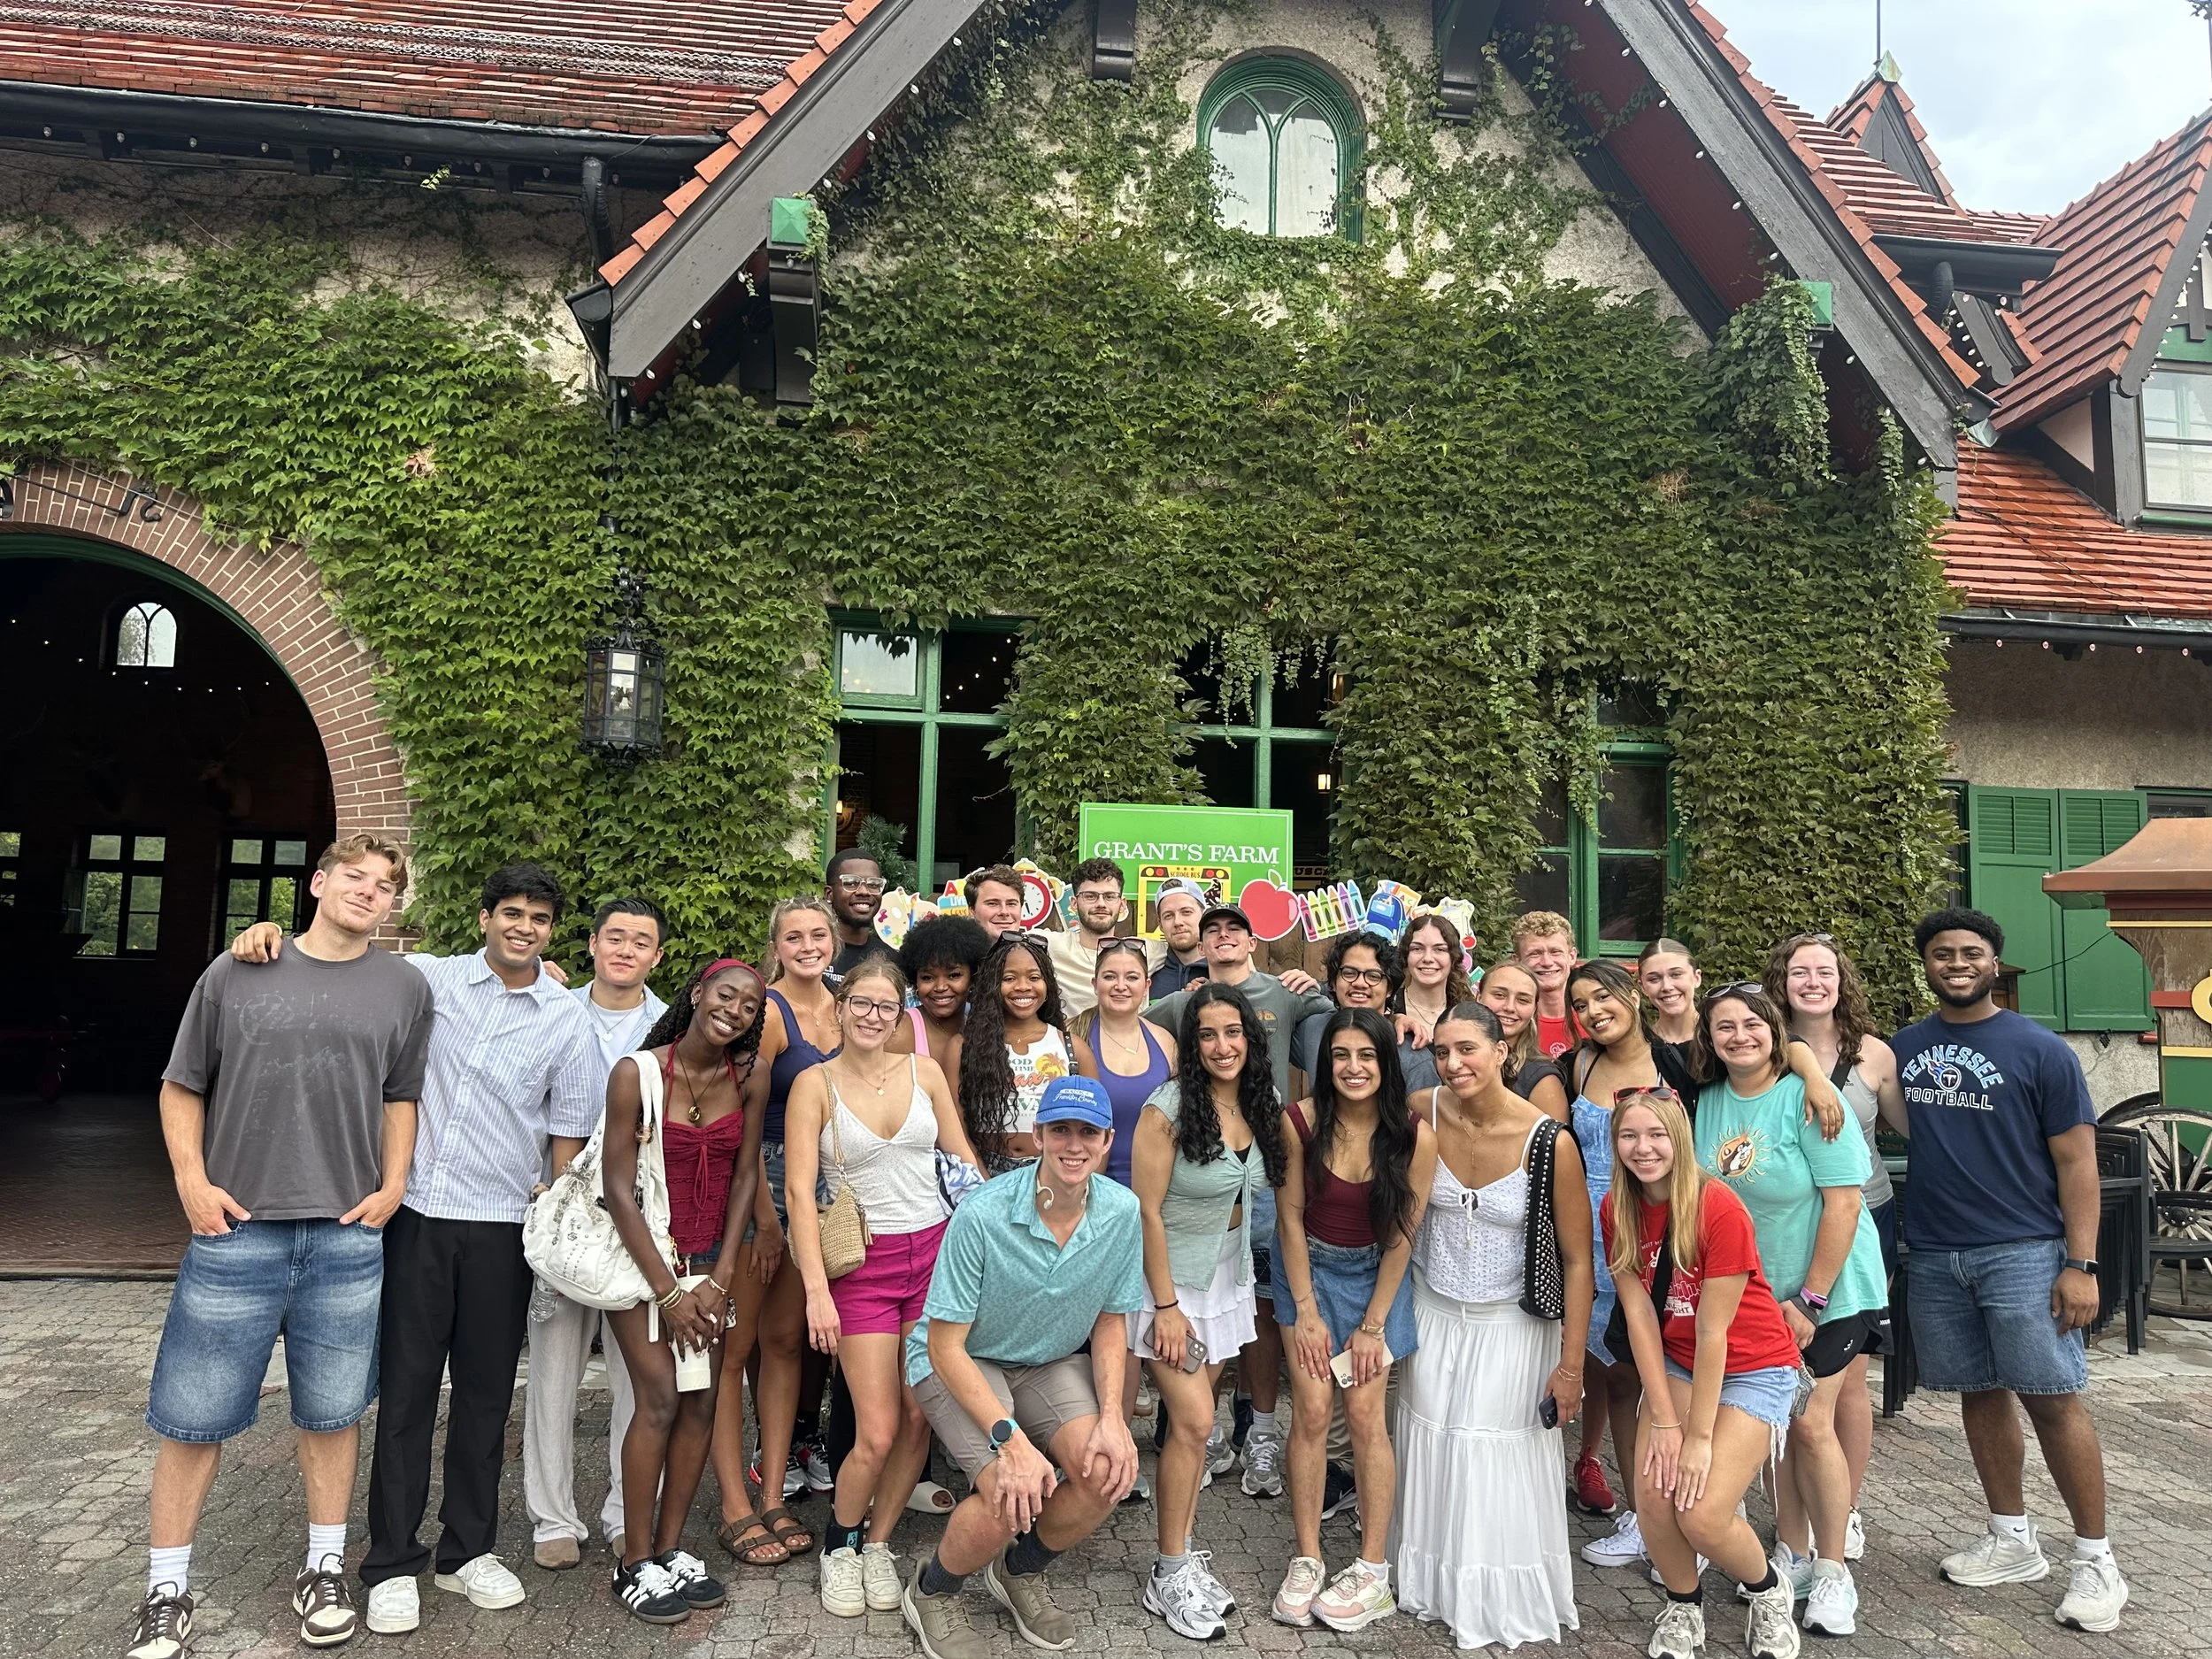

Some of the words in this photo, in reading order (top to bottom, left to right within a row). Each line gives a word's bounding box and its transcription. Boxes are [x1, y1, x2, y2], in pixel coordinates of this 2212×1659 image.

[1094, 841, 1202, 861] GRANT'S
[1209, 844, 1279, 864] FARM
[945, 881, 958, 896] A
[1902, 1044, 2004, 1089] TENNESSEE
[1904, 1087, 1993, 1110] FOOTBALL
